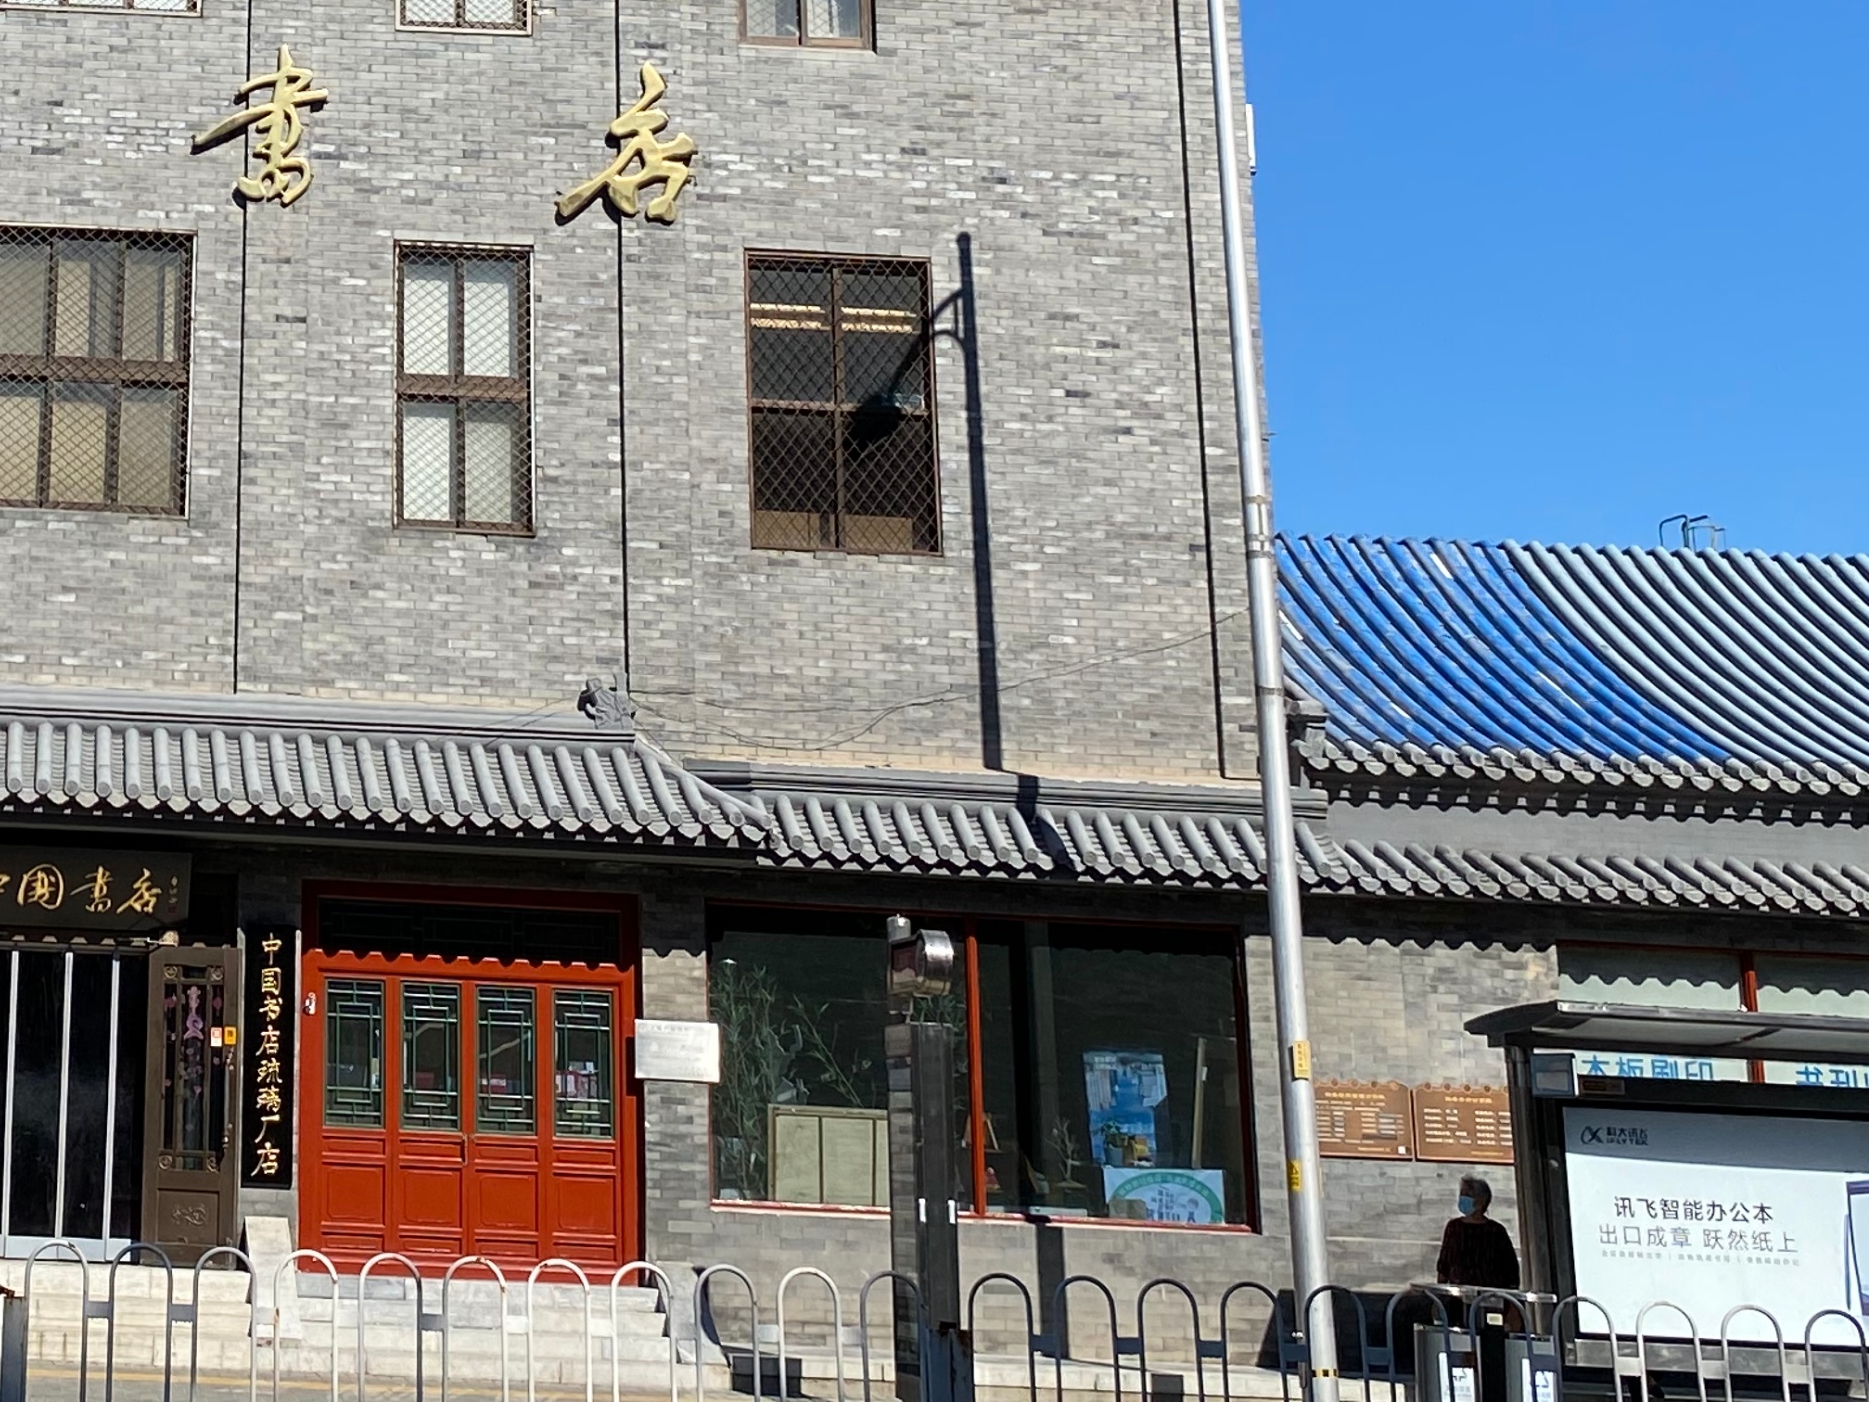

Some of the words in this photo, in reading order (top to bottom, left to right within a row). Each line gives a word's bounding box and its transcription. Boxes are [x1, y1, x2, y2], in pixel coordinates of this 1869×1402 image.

[251, 933, 283, 1176] 中国书店琉璃厂店
[1614, 1196, 1773, 1224] 讯飞智能办公本
[1599, 1223, 1692, 1248] 出口成章
[1702, 1228, 1798, 1253] 跃然纸上
